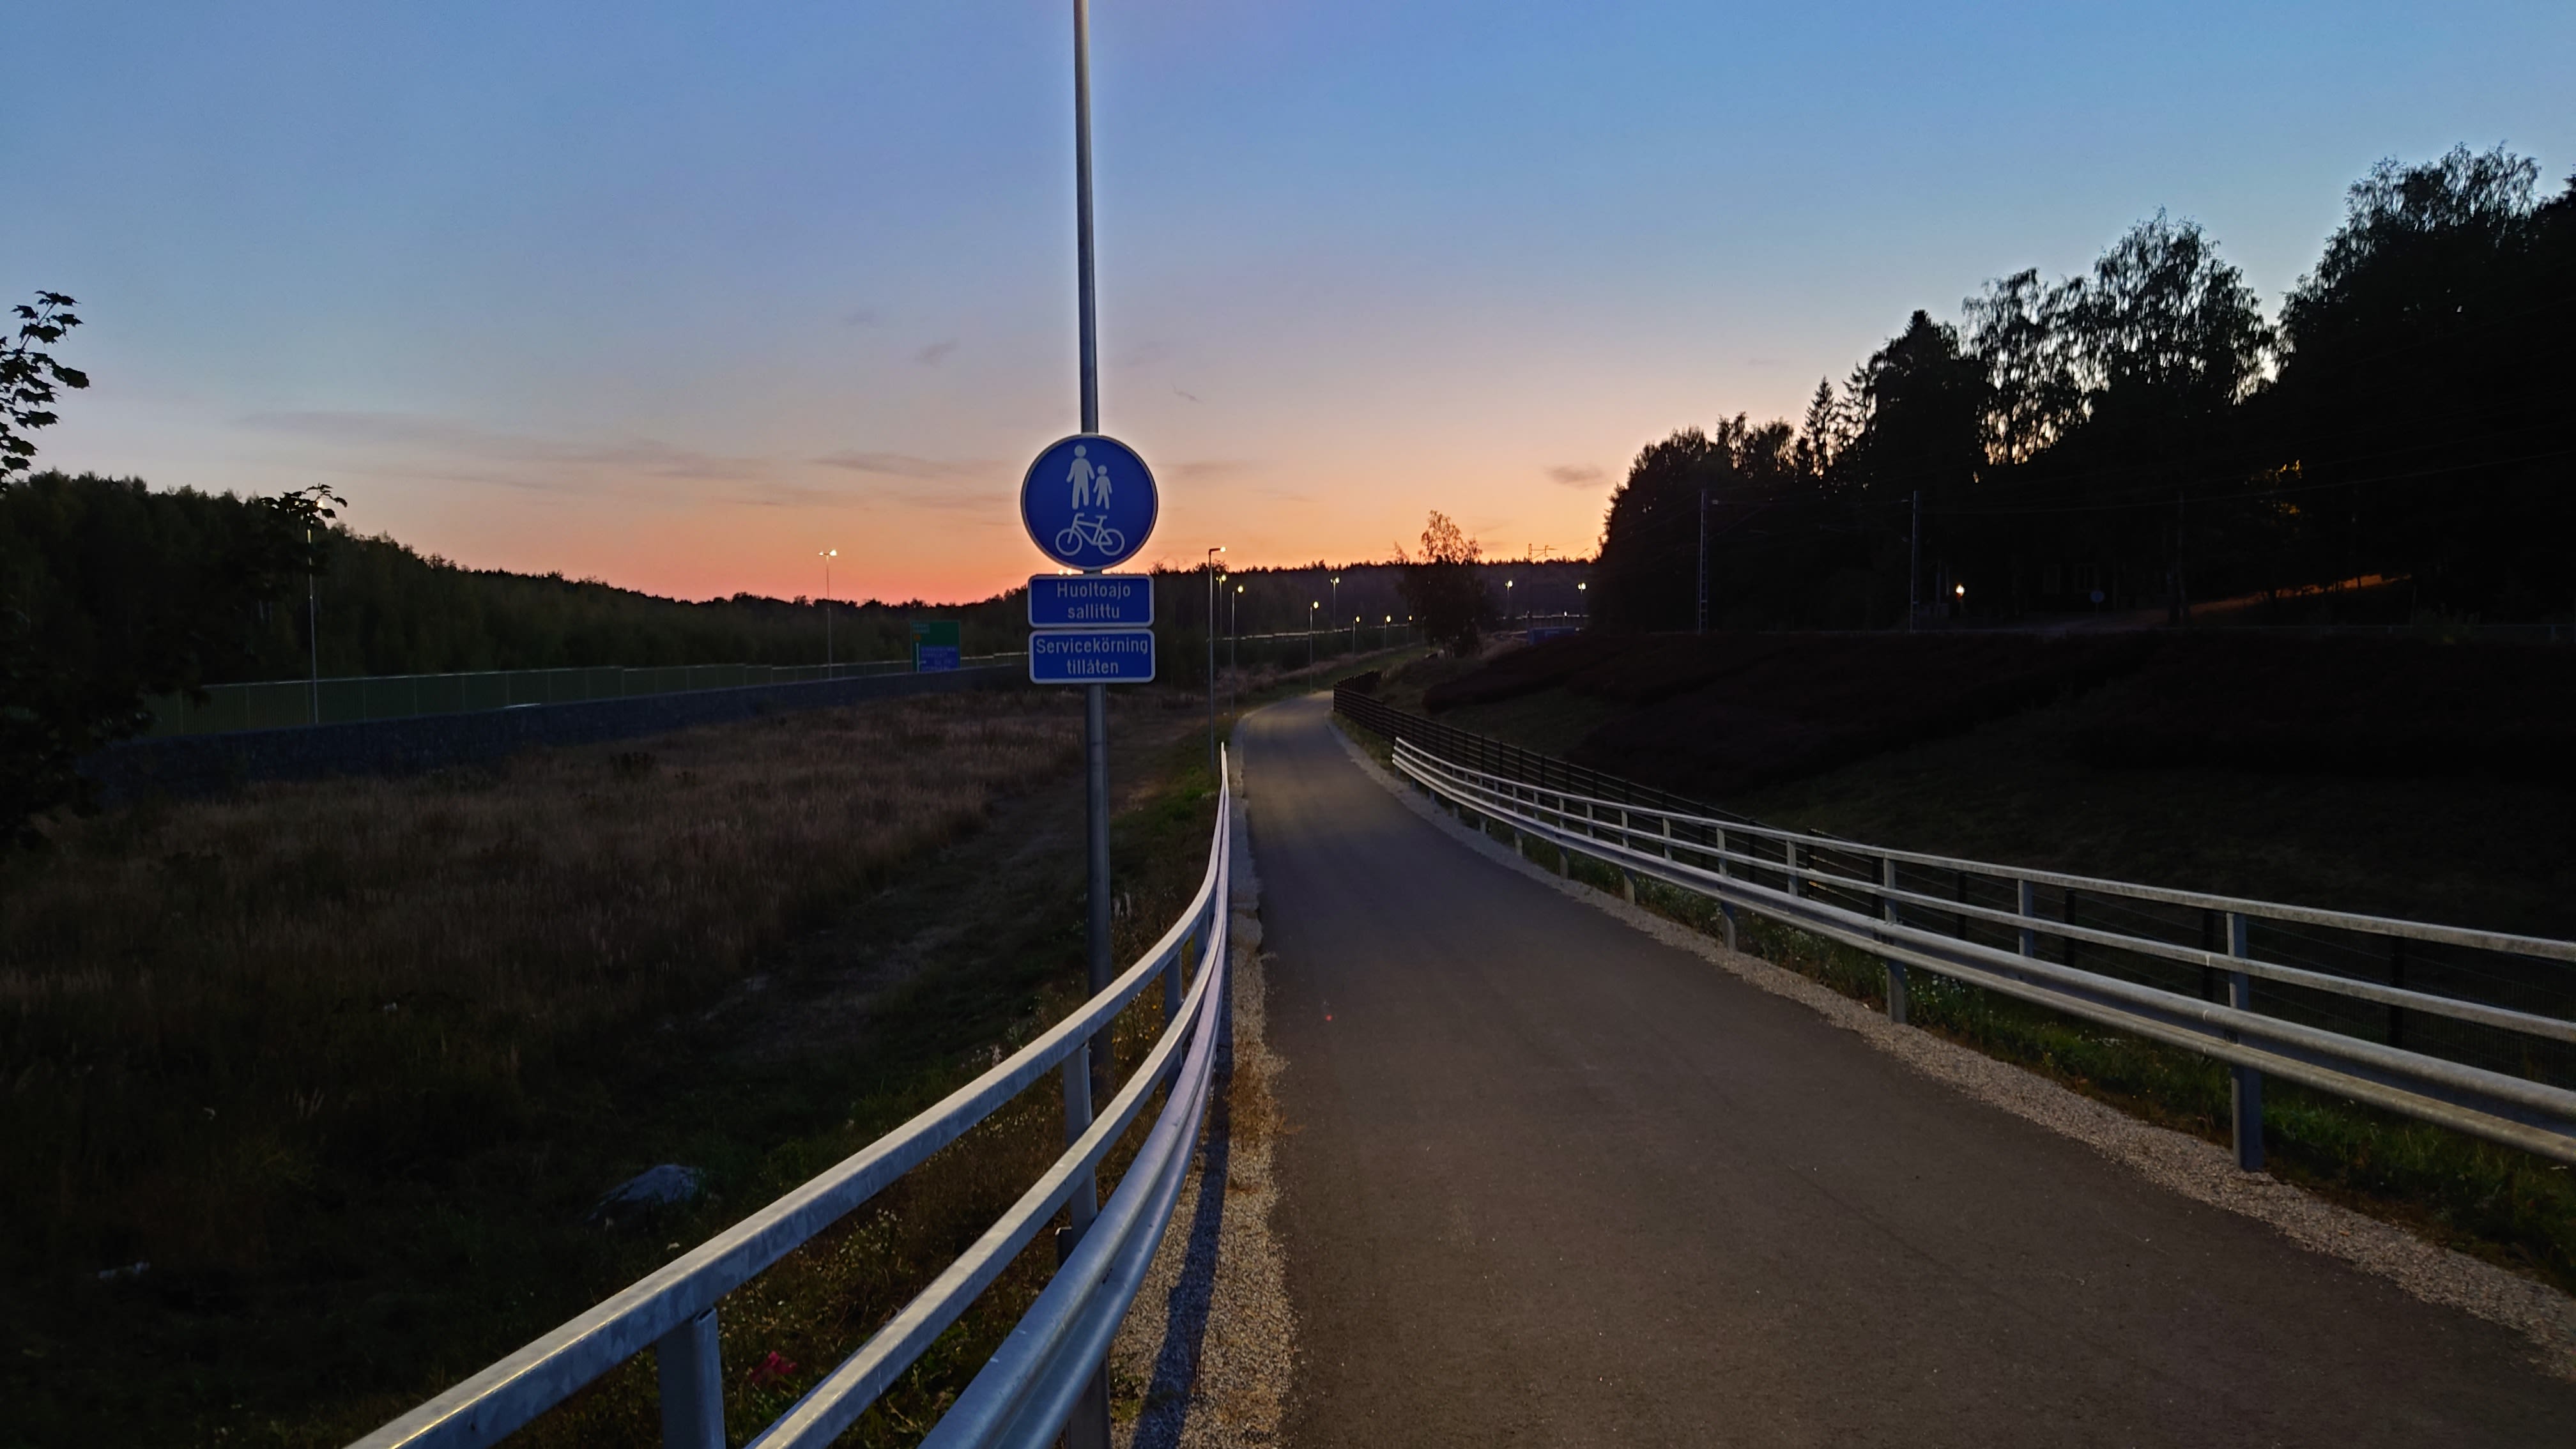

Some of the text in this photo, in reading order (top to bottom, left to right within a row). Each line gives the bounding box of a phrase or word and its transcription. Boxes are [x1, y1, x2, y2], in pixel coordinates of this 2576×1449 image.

[1057, 582, 1131, 600] Huoltoajo
[1068, 603, 1120, 619] sallittu
[1036, 637, 1148, 655] Servicekörning
[1066, 659, 1119, 675] tillåten
